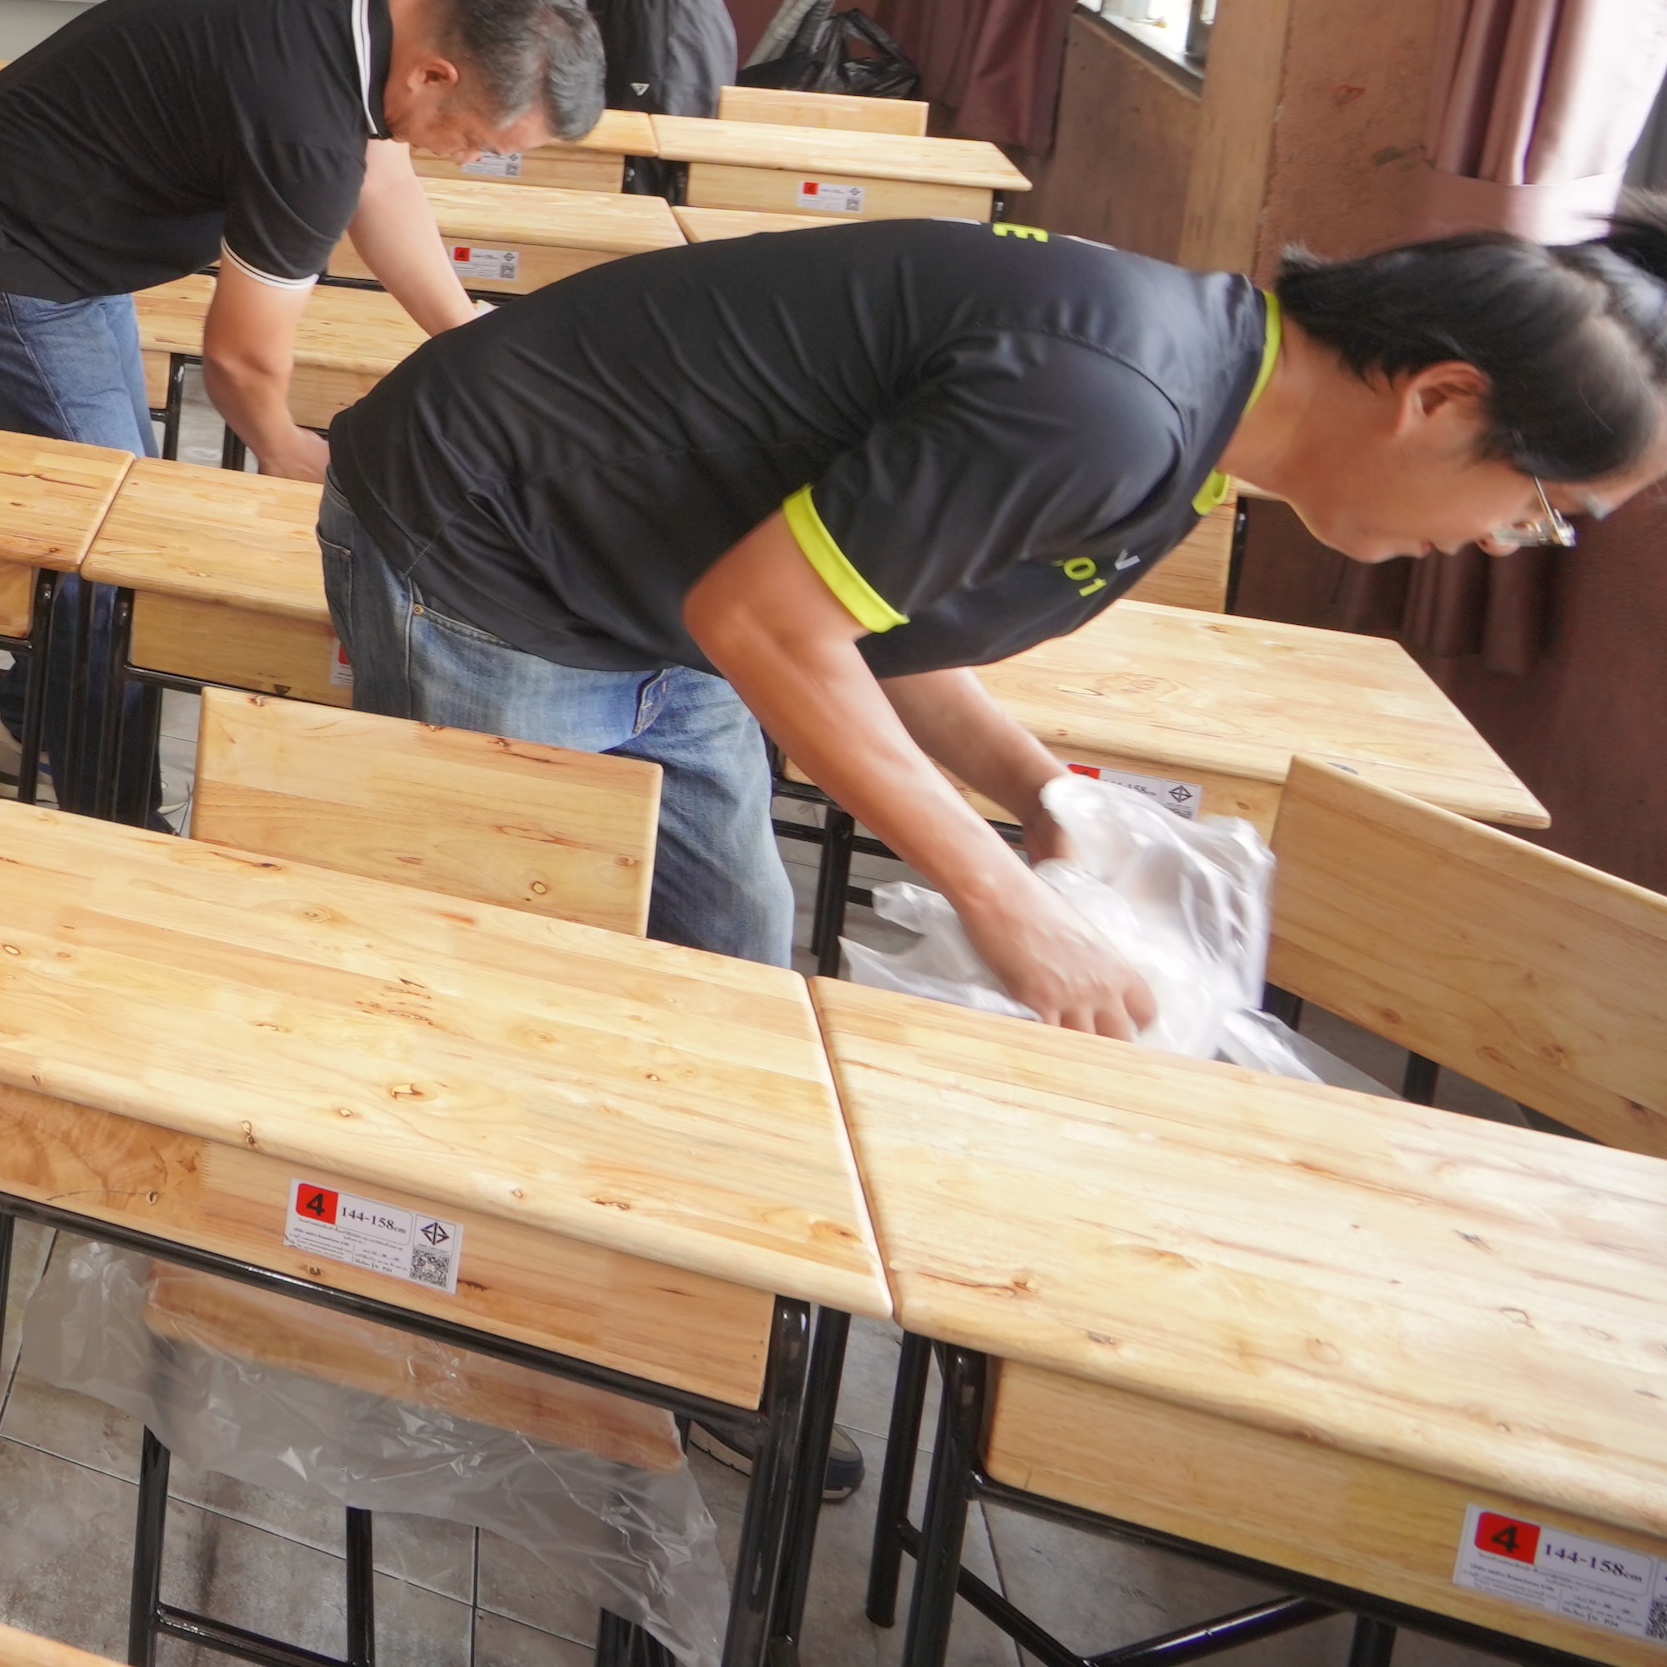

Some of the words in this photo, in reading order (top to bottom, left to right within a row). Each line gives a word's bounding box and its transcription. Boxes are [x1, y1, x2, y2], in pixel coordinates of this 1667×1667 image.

[305, 1192, 325, 1217] 4
[339, 1205, 407, 1236] 144-158cm
[1490, 1523, 1521, 1553] 4
[1545, 1542, 1644, 1584] 144-158cm
